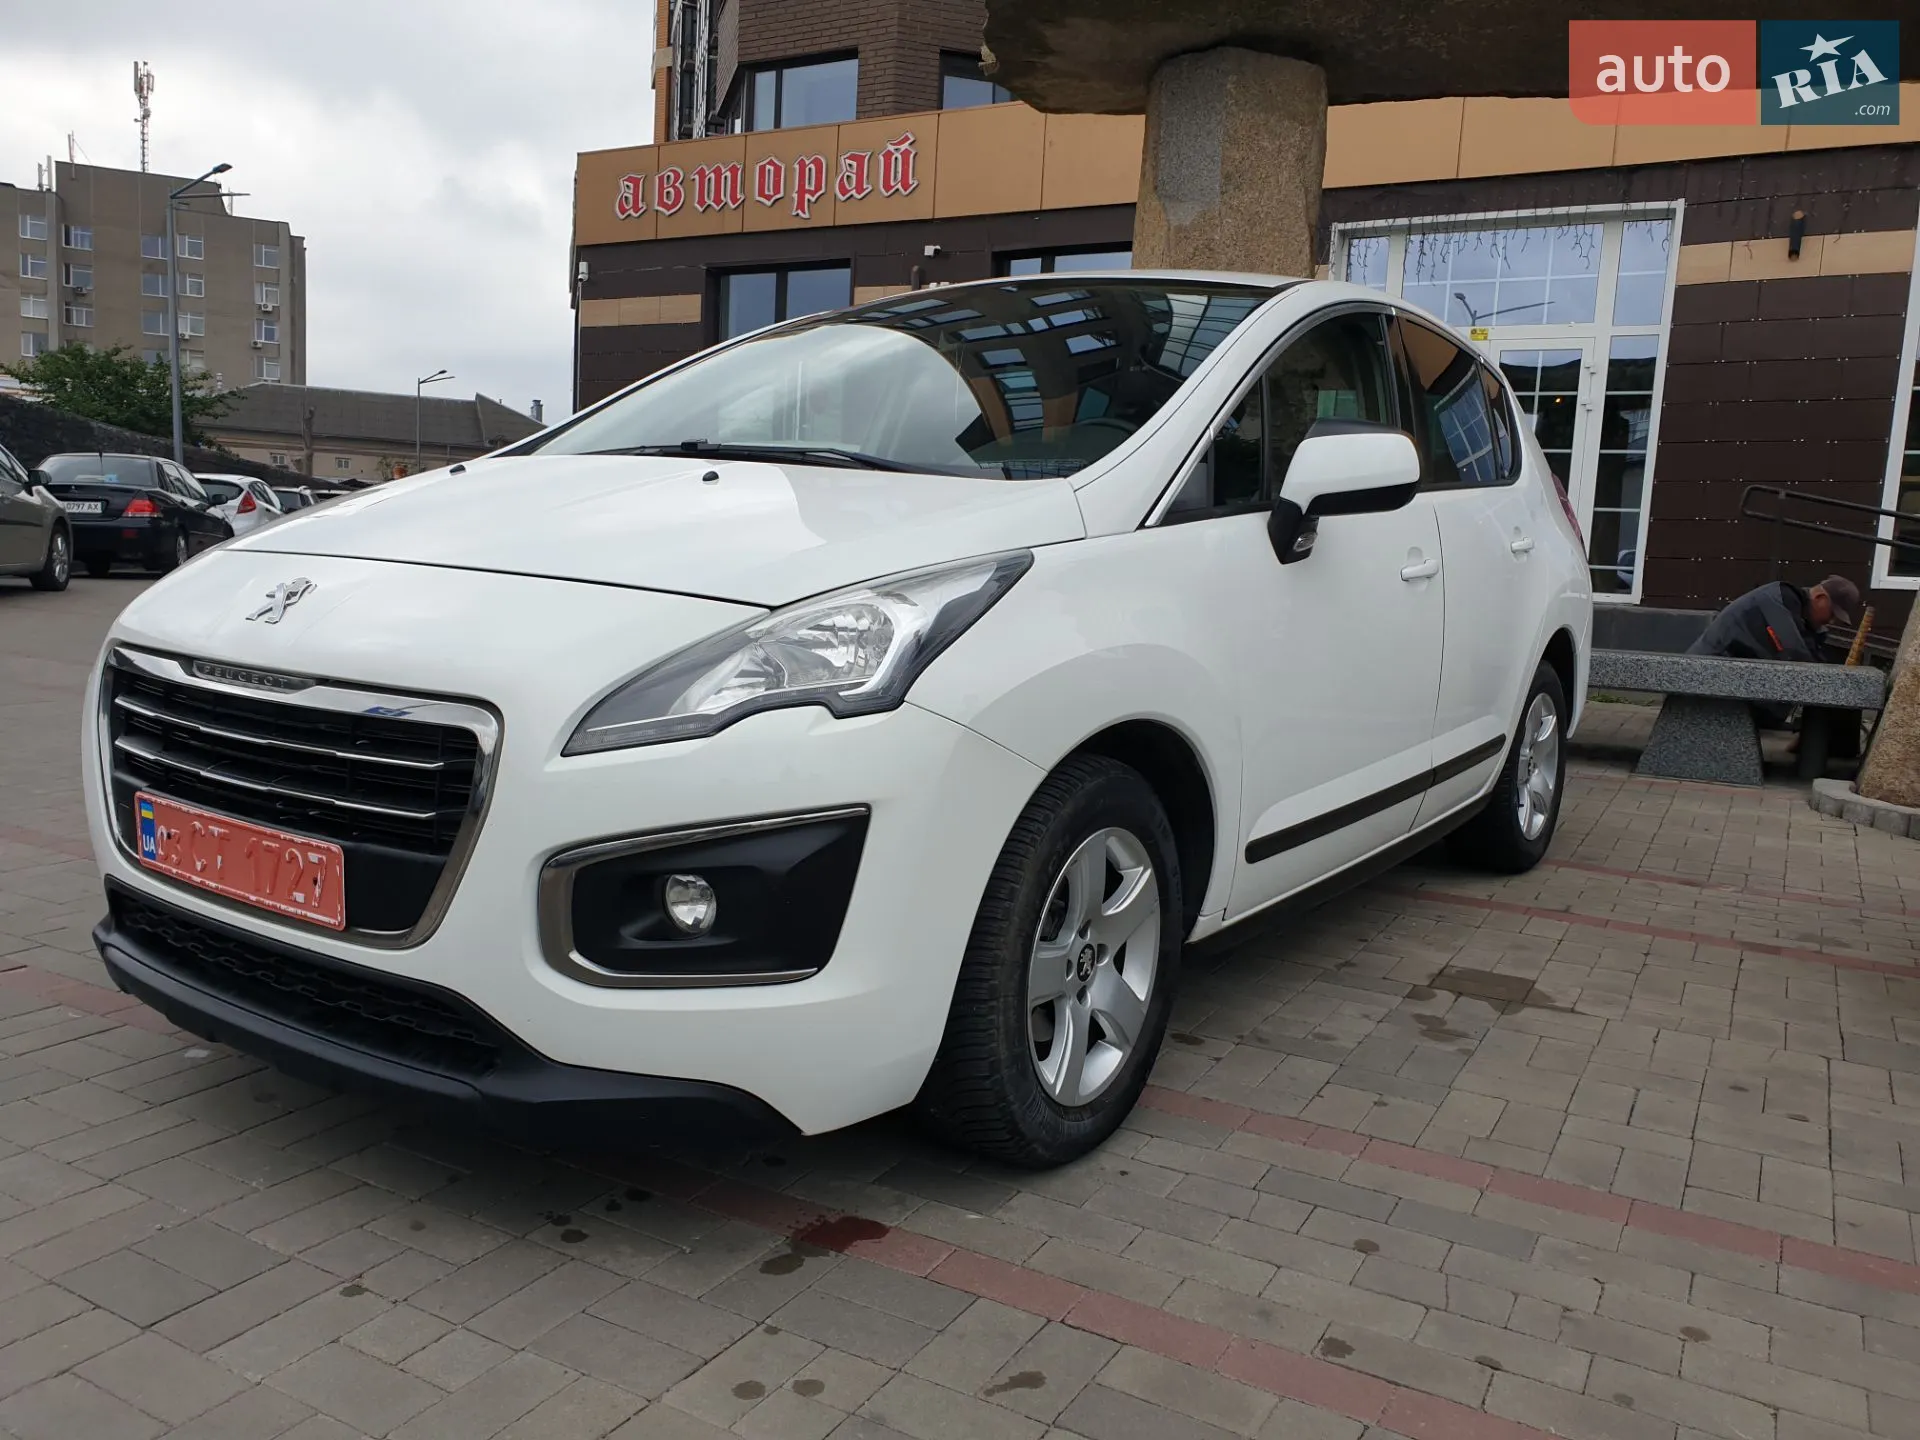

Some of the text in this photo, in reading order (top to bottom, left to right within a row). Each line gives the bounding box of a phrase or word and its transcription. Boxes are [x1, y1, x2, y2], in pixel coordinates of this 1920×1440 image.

[615, 131, 919, 219] авторай
[203, 665, 288, 688] PEUGEOT
[142, 833, 156, 854] UA
